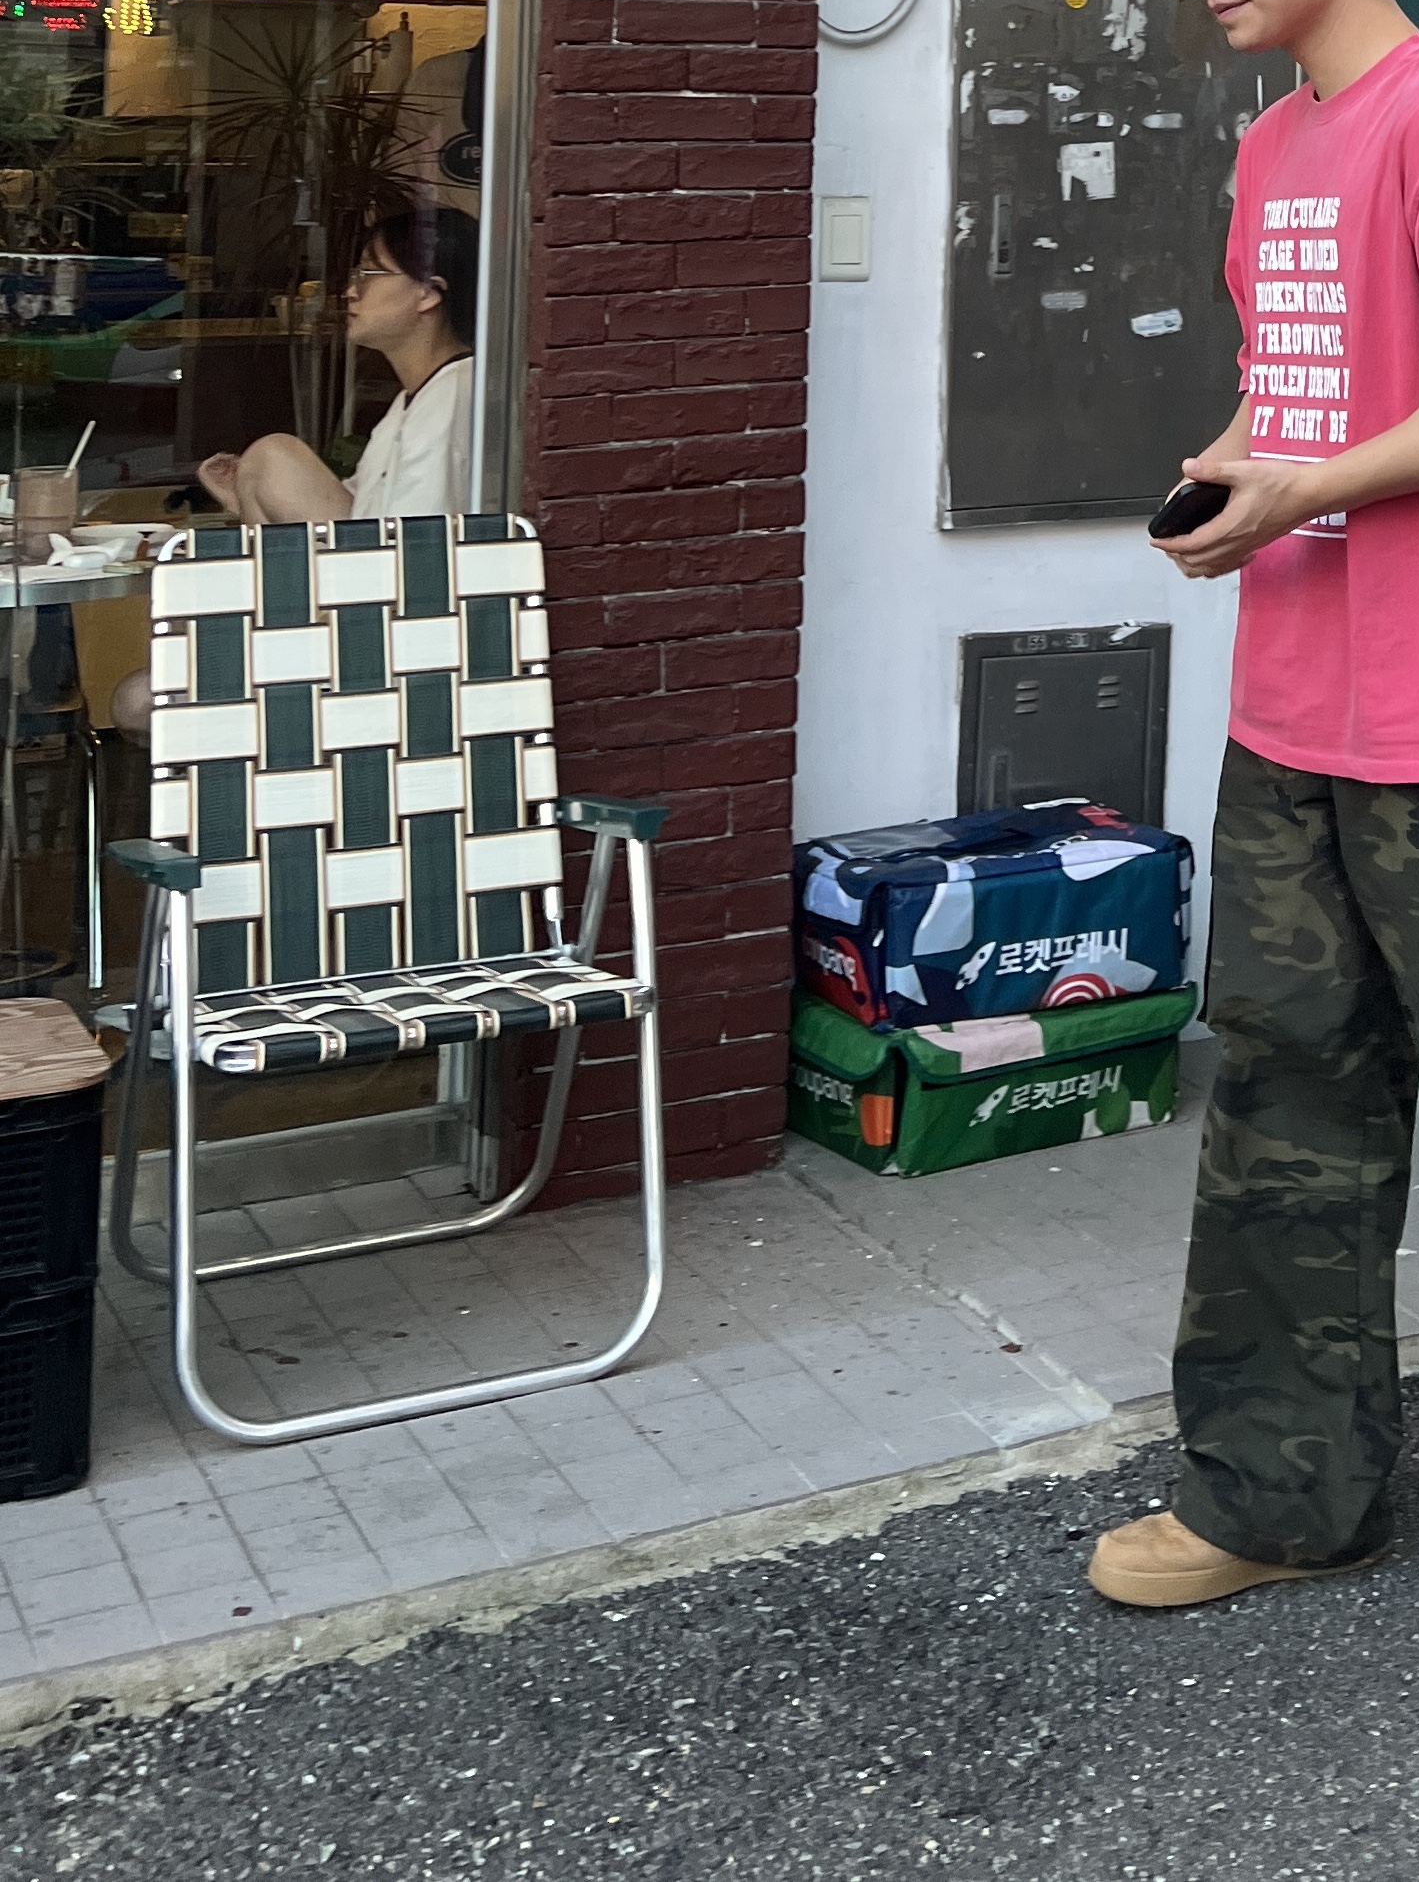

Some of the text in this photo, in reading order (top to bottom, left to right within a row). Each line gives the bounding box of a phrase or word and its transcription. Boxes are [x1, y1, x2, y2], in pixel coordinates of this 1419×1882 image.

[1258, 240, 1295, 271] STAGE
[1249, 364, 1307, 397] STOLEN
[1307, 366, 1341, 399] DRUM
[1251, 406, 1348, 443] IT MIGHT BE
[801, 934, 858, 992] oupang
[995, 927, 1128, 976] 로켓프레시
[791, 1063, 855, 1114] oupang
[1006, 1065, 1123, 1114] 로켓프레시
